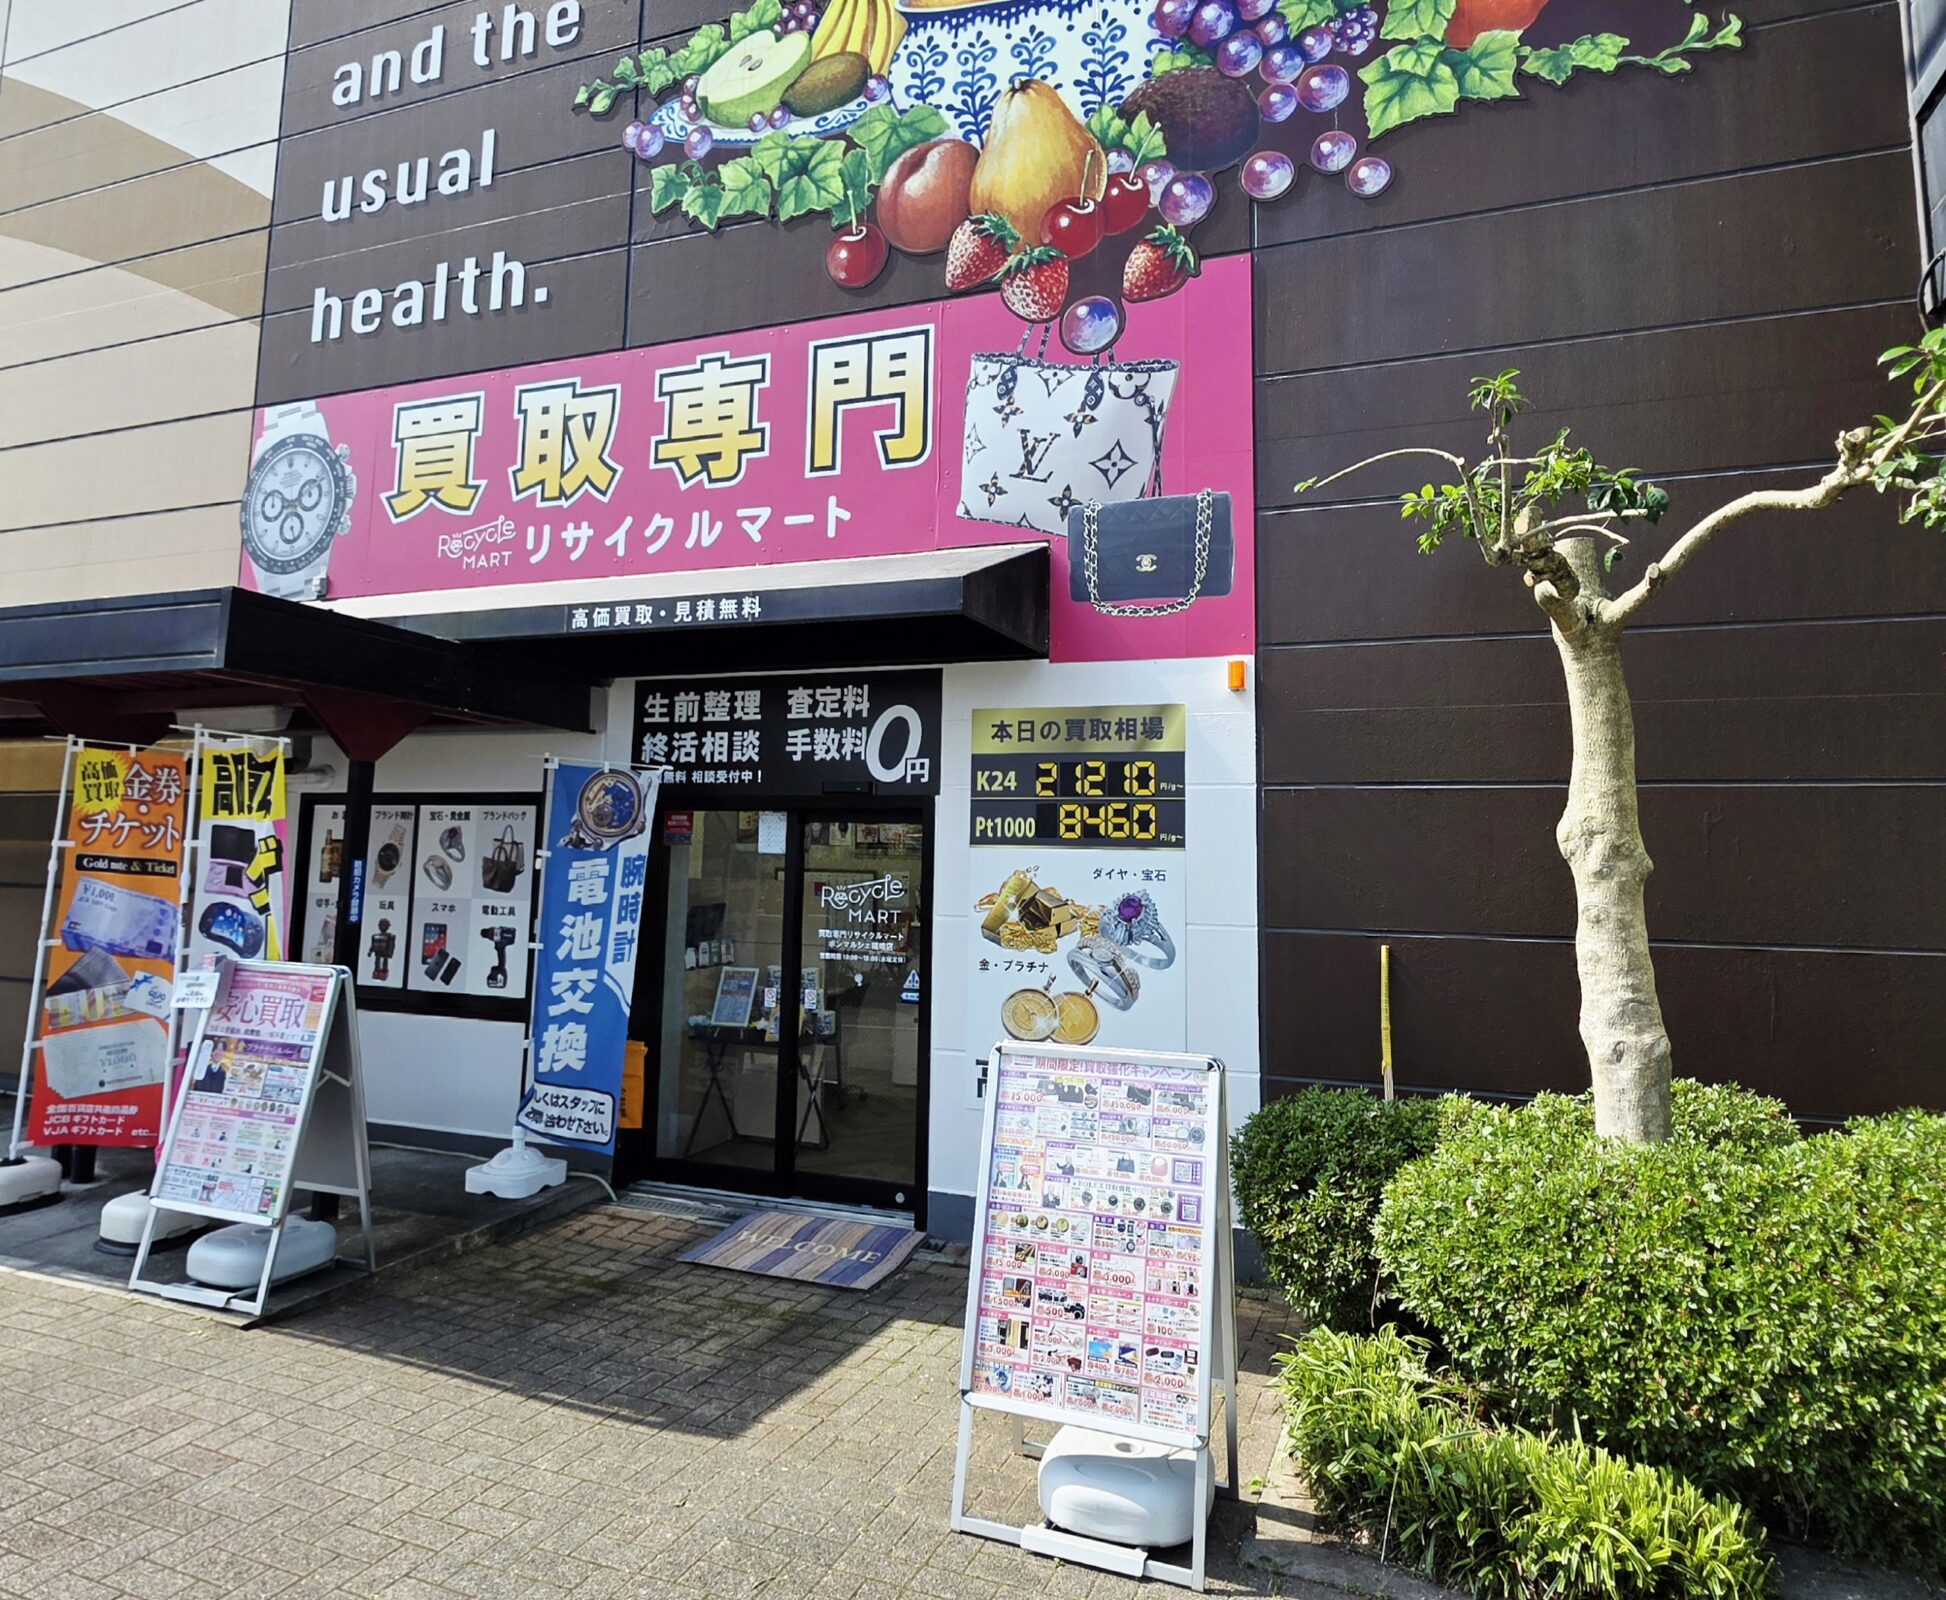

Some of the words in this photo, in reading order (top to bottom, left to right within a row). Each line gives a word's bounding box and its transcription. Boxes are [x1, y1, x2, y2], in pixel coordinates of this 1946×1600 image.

[332, 24, 447, 107] and
[471, 0, 582, 67] the
[321, 128, 496, 223] usual
[310, 251, 549, 344] health.
[379, 323, 936, 522] 買取専門
[438, 515, 516, 558] Recycle
[525, 495, 852, 565] リサイクルマート
[463, 551, 512, 570] MART
[571, 595, 762, 630] 高価買取・見積無料
[643, 689, 762, 723] 生前整理
[786, 683, 870, 719] 査定料
[640, 730, 761, 764] 終活相談
[785, 726, 867, 761] 手数料
[991, 716, 1165, 743] 本日の買取相場
[82, 761, 118, 781] 高価
[124, 763, 181, 805] 金券
[976, 771, 1017, 791] K24
[1035, 761, 1157, 797] 21210
[83, 781, 120, 803] 買取
[81, 811, 181, 850] チケット
[429, 811, 471, 821] 宝石・貴金属
[483, 811, 527, 821] ブランドバッグ
[975, 817, 1036, 838] Pt1000
[1059, 803, 1157, 840] 8460
[83, 857, 108, 870] Gold
[130, 861, 142, 872] &
[145, 863, 175, 875] Ticket
[1093, 867, 1167, 882] ダイヤ・宝石
[379, 901, 395, 911] 玩具
[432, 903, 456, 913] スマホ
[612, 854, 647, 965] 腕時計
[821, 874, 905, 910] Recycle
[482, 905, 516, 917] 電動工具
[848, 908, 902, 924] MART
[538, 859, 610, 1073] 電池交換
[214, 991, 305, 1030] 安心買取
[43, 1126, 69, 1136] VJA
[71, 1126, 123, 1136] ギフトカード
[73, 1115, 125, 1125] ギフトカード
[737, 1229, 882, 1265] WELCOME
